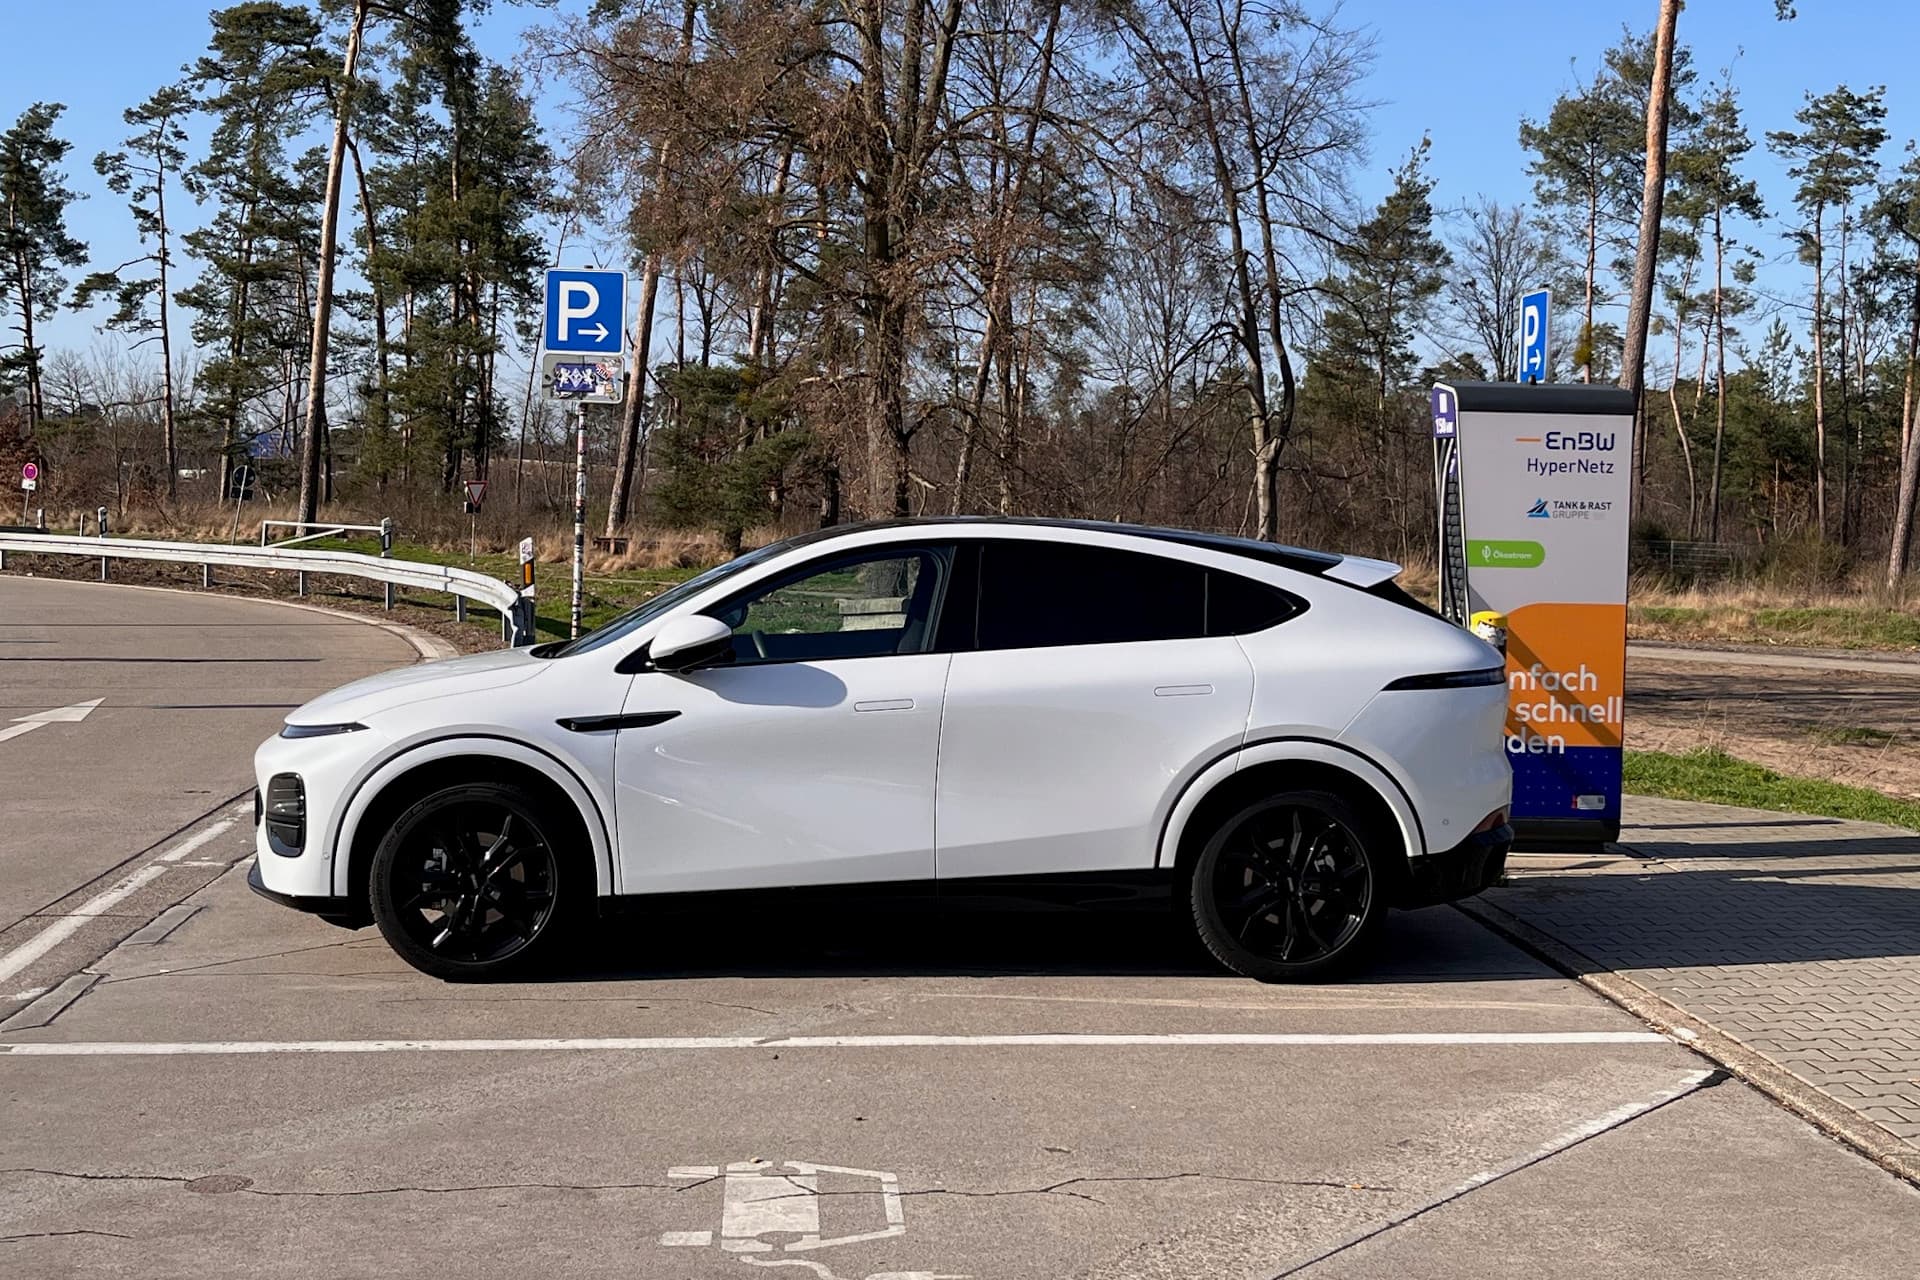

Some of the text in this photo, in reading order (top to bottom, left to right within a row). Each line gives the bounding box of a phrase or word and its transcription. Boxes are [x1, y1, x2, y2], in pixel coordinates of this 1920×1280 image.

[557, 280, 600, 342] P
[1522, 304, 1540, 373] P
[1545, 431, 1615, 451] EnBW
[1527, 457, 1614, 476] HyperNetz
[1552, 510, 1590, 519] GRUPPE
[1553, 500, 1612, 511] TANK & RAST
[1508, 662, 1598, 691] nfach
[1514, 695, 1622, 724] schnell
[1504, 726, 1565, 755] den
